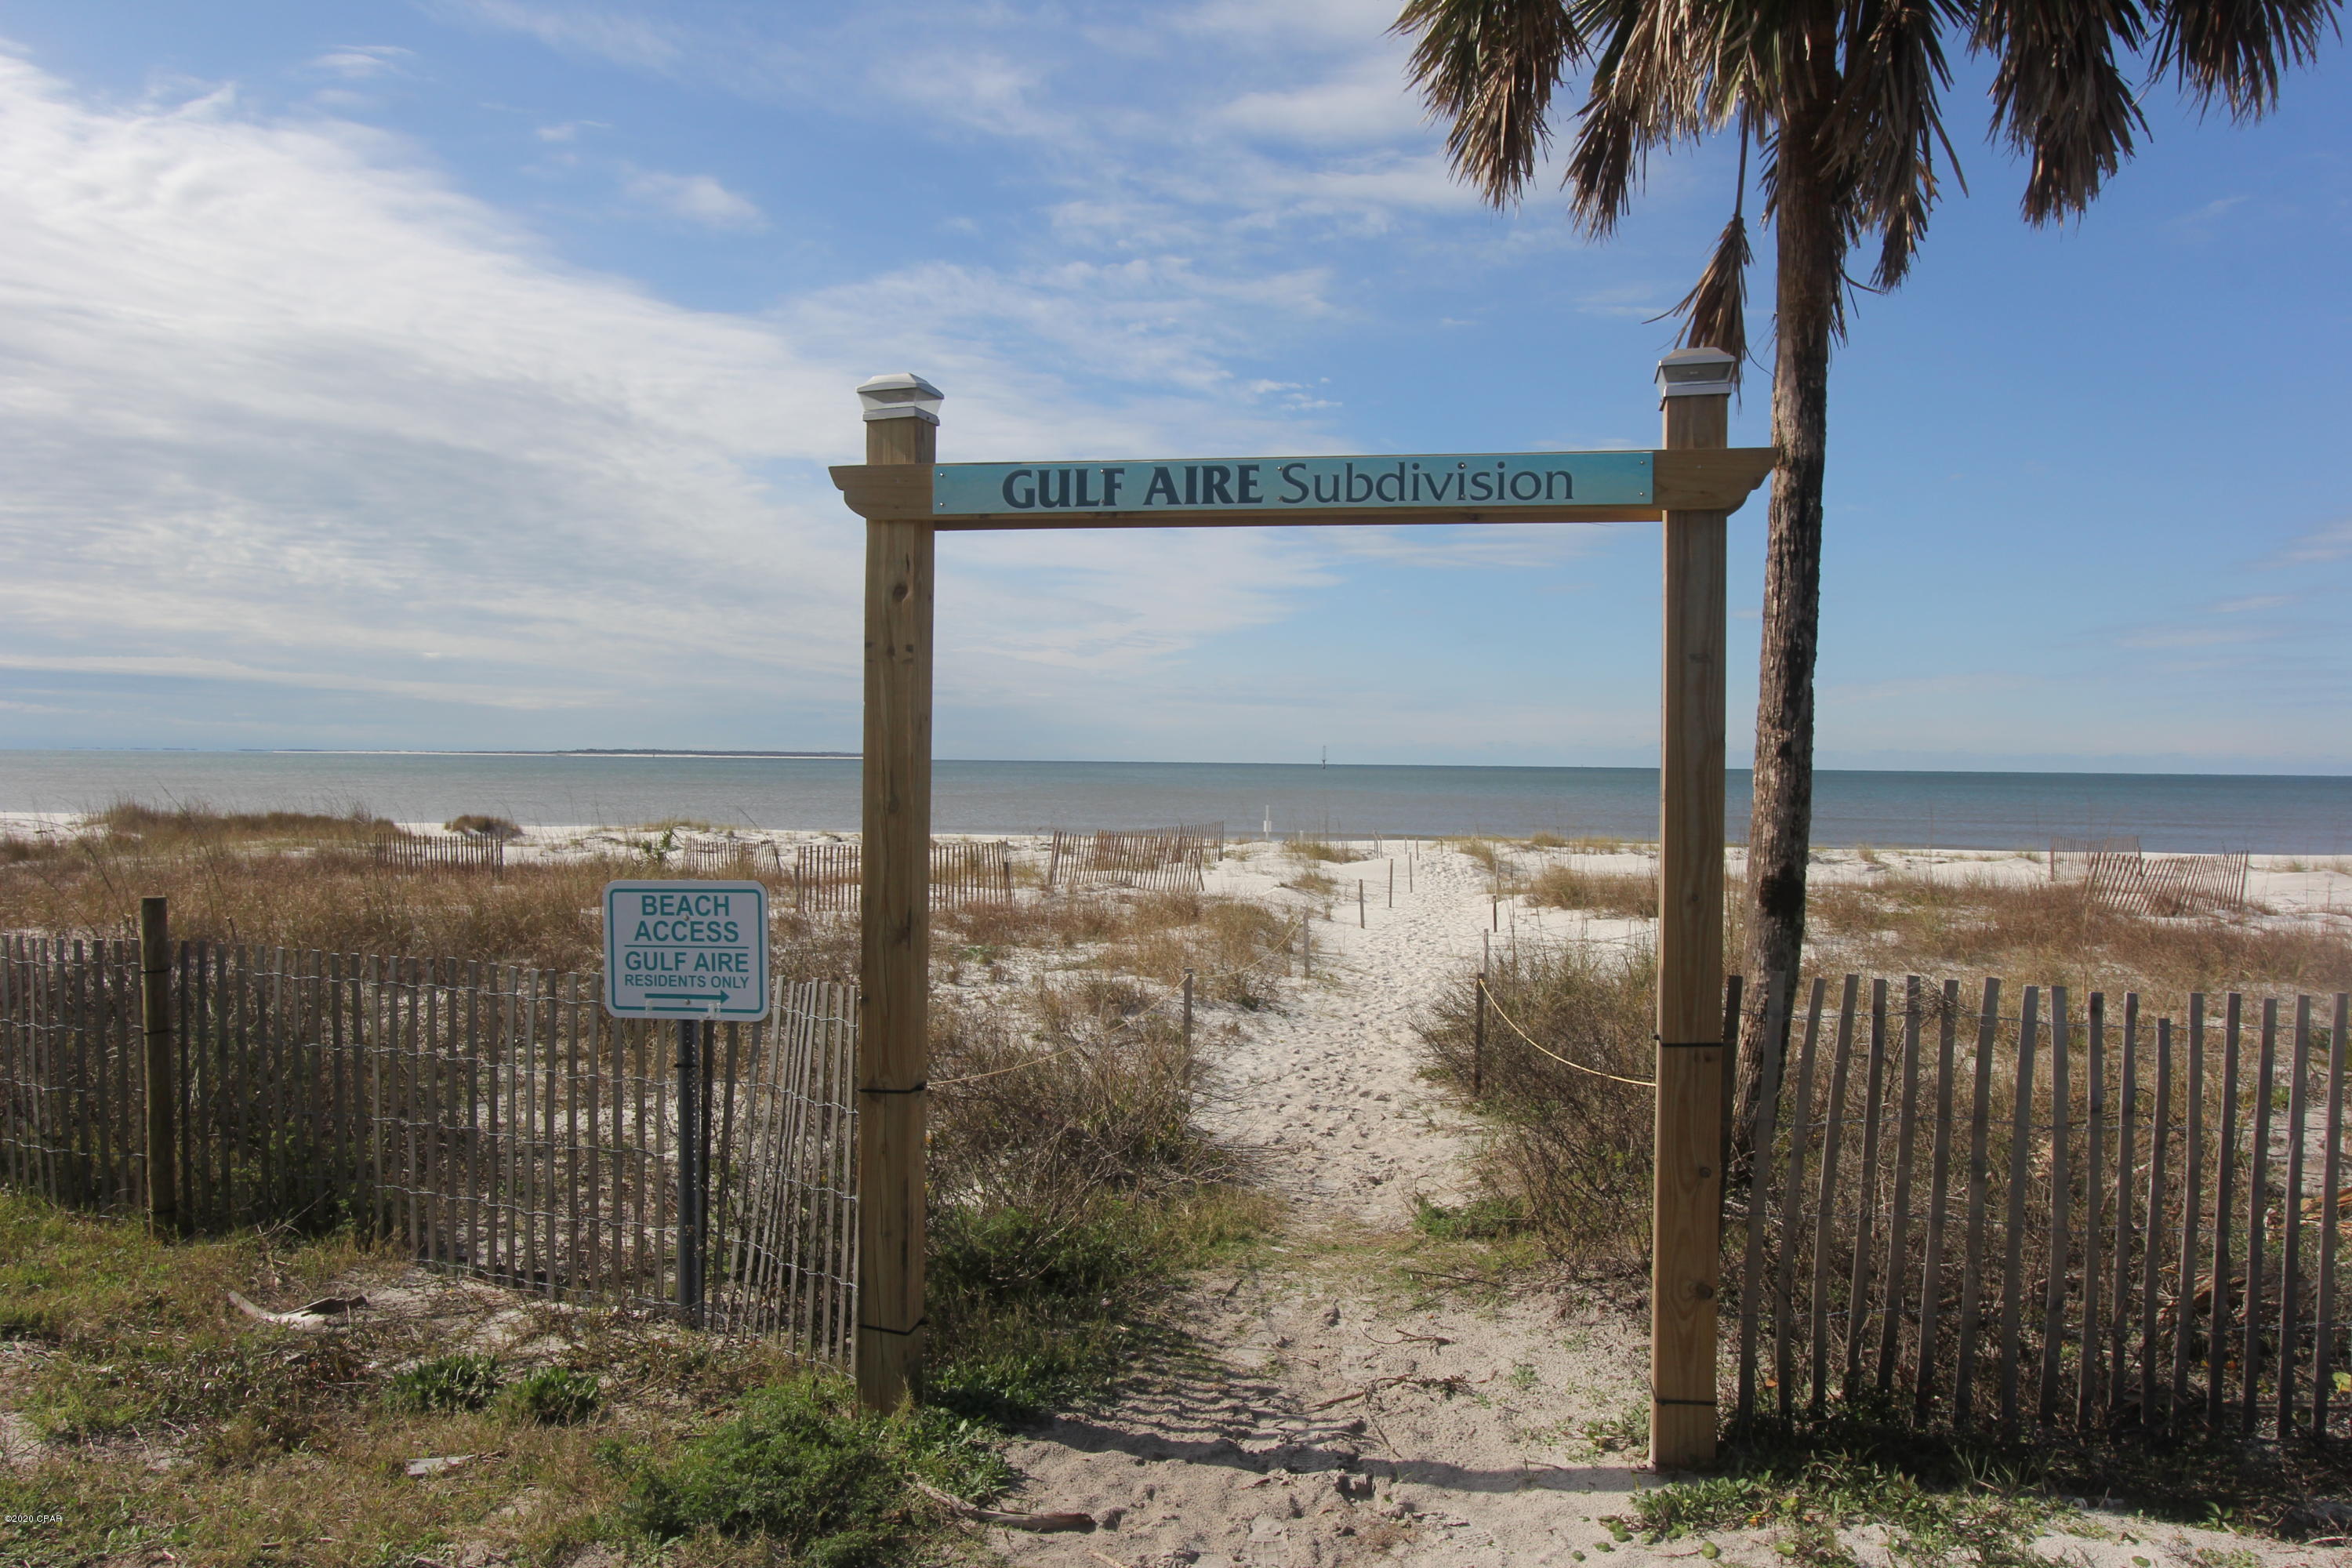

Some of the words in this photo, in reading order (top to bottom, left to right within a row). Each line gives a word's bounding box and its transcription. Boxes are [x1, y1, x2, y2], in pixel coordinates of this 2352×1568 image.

[1001, 468, 1126, 510] GULF
[1142, 463, 1265, 506] AIRE
[1279, 461, 1575, 505] Subdivision
[641, 895, 730, 916] BEACH
[633, 920, 739, 942] ACCESS
[625, 951, 687, 971] GULF
[694, 953, 750, 972] AIRE
[624, 974, 706, 988] RESIDENTS
[710, 975, 750, 989] ONLY
